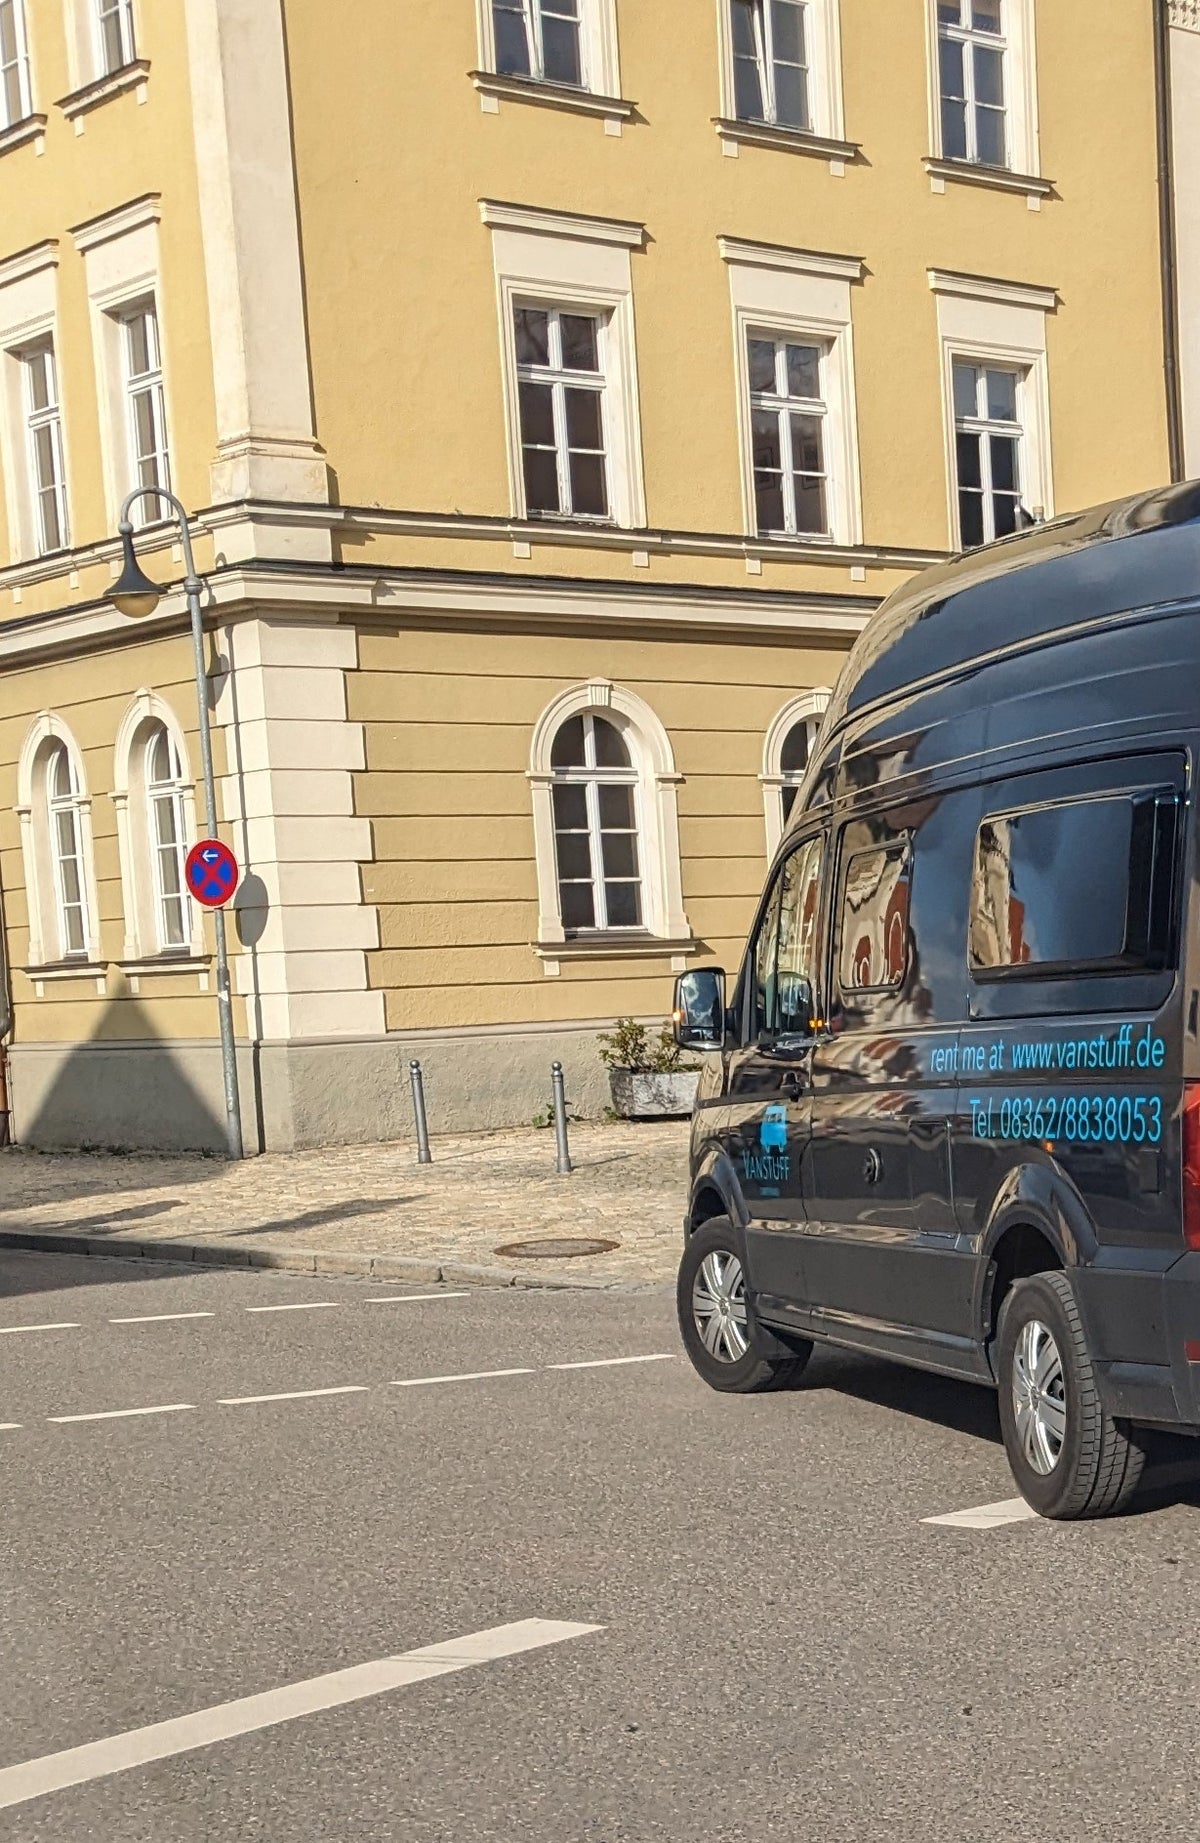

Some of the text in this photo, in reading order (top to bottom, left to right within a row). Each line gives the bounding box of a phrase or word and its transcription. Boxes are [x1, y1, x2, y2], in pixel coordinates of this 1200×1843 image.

[930, 1023, 1165, 1072] rent me at www.vanstuff.de
[969, 1095, 1162, 1142] Tel. 08362/8838053
